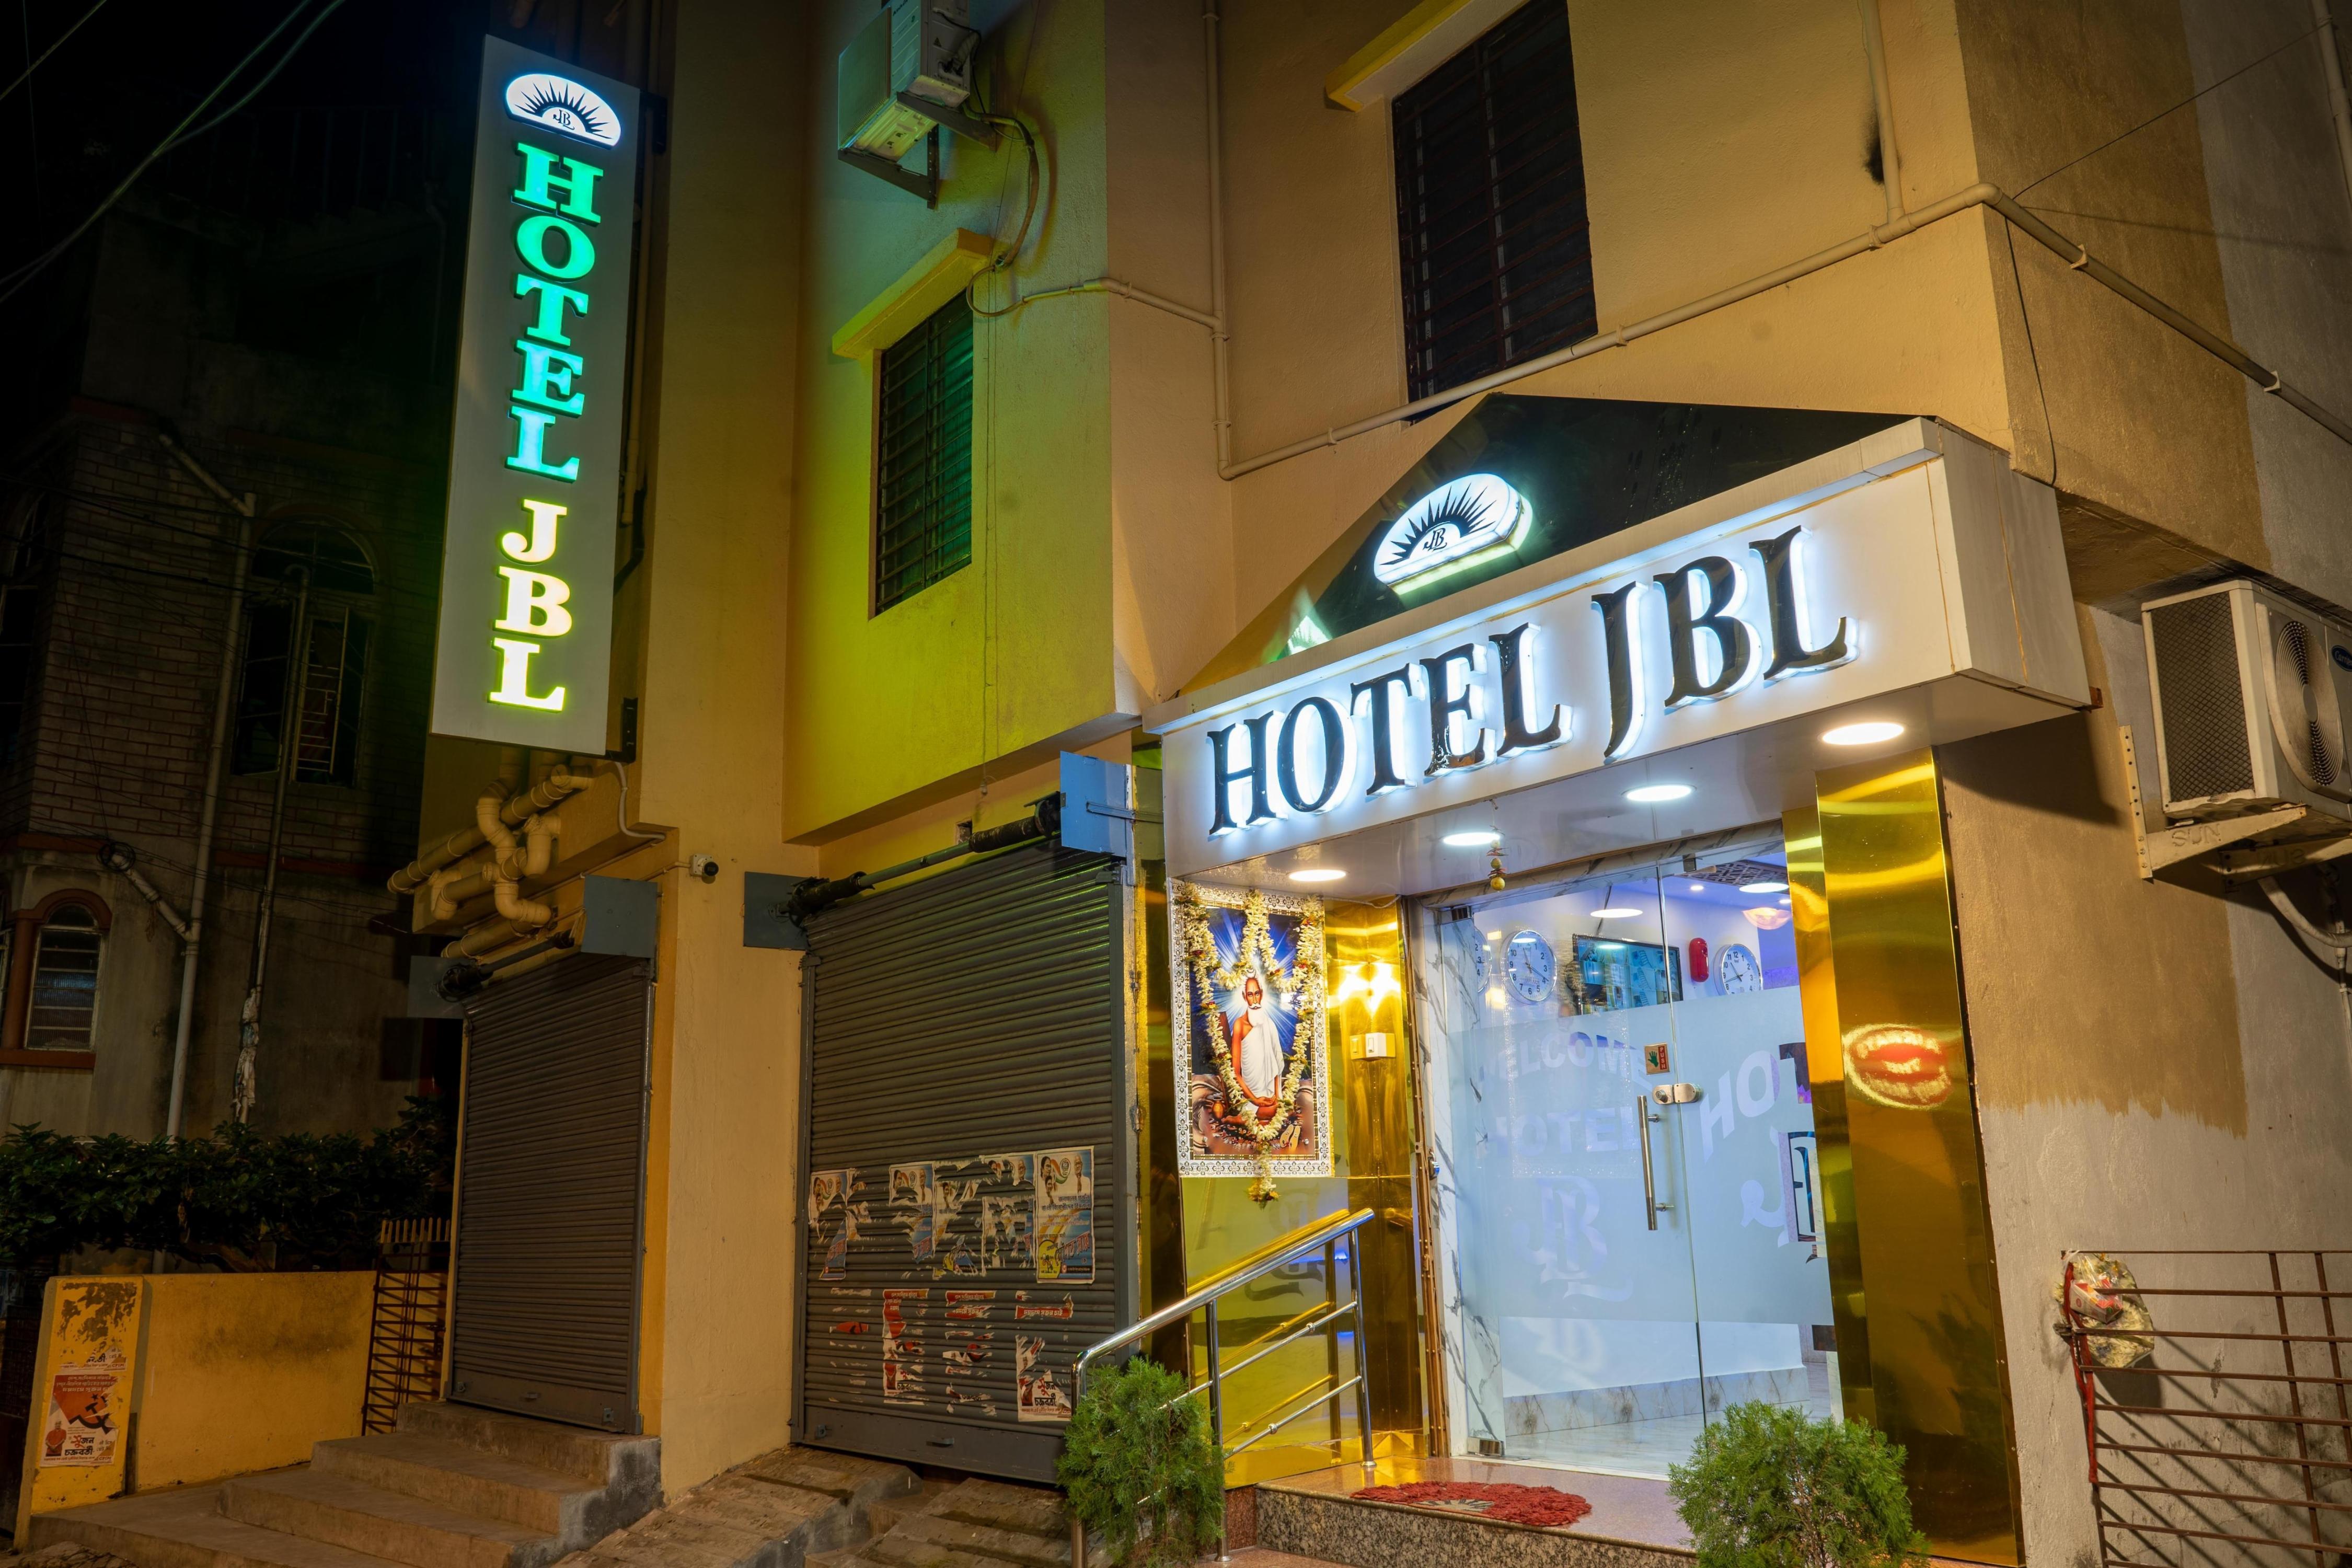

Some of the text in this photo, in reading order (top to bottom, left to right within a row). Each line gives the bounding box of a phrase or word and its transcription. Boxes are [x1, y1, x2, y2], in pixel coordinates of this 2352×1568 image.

[506, 141, 604, 482] HOTEL
[488, 498, 572, 711] JBL
[1207, 525, 1858, 836] HOTEL JBL
[2172, 824, 2221, 847] SUN
[1700, 1042, 1812, 1163] HOT
[71, 1435, 95, 1448] সুজন
